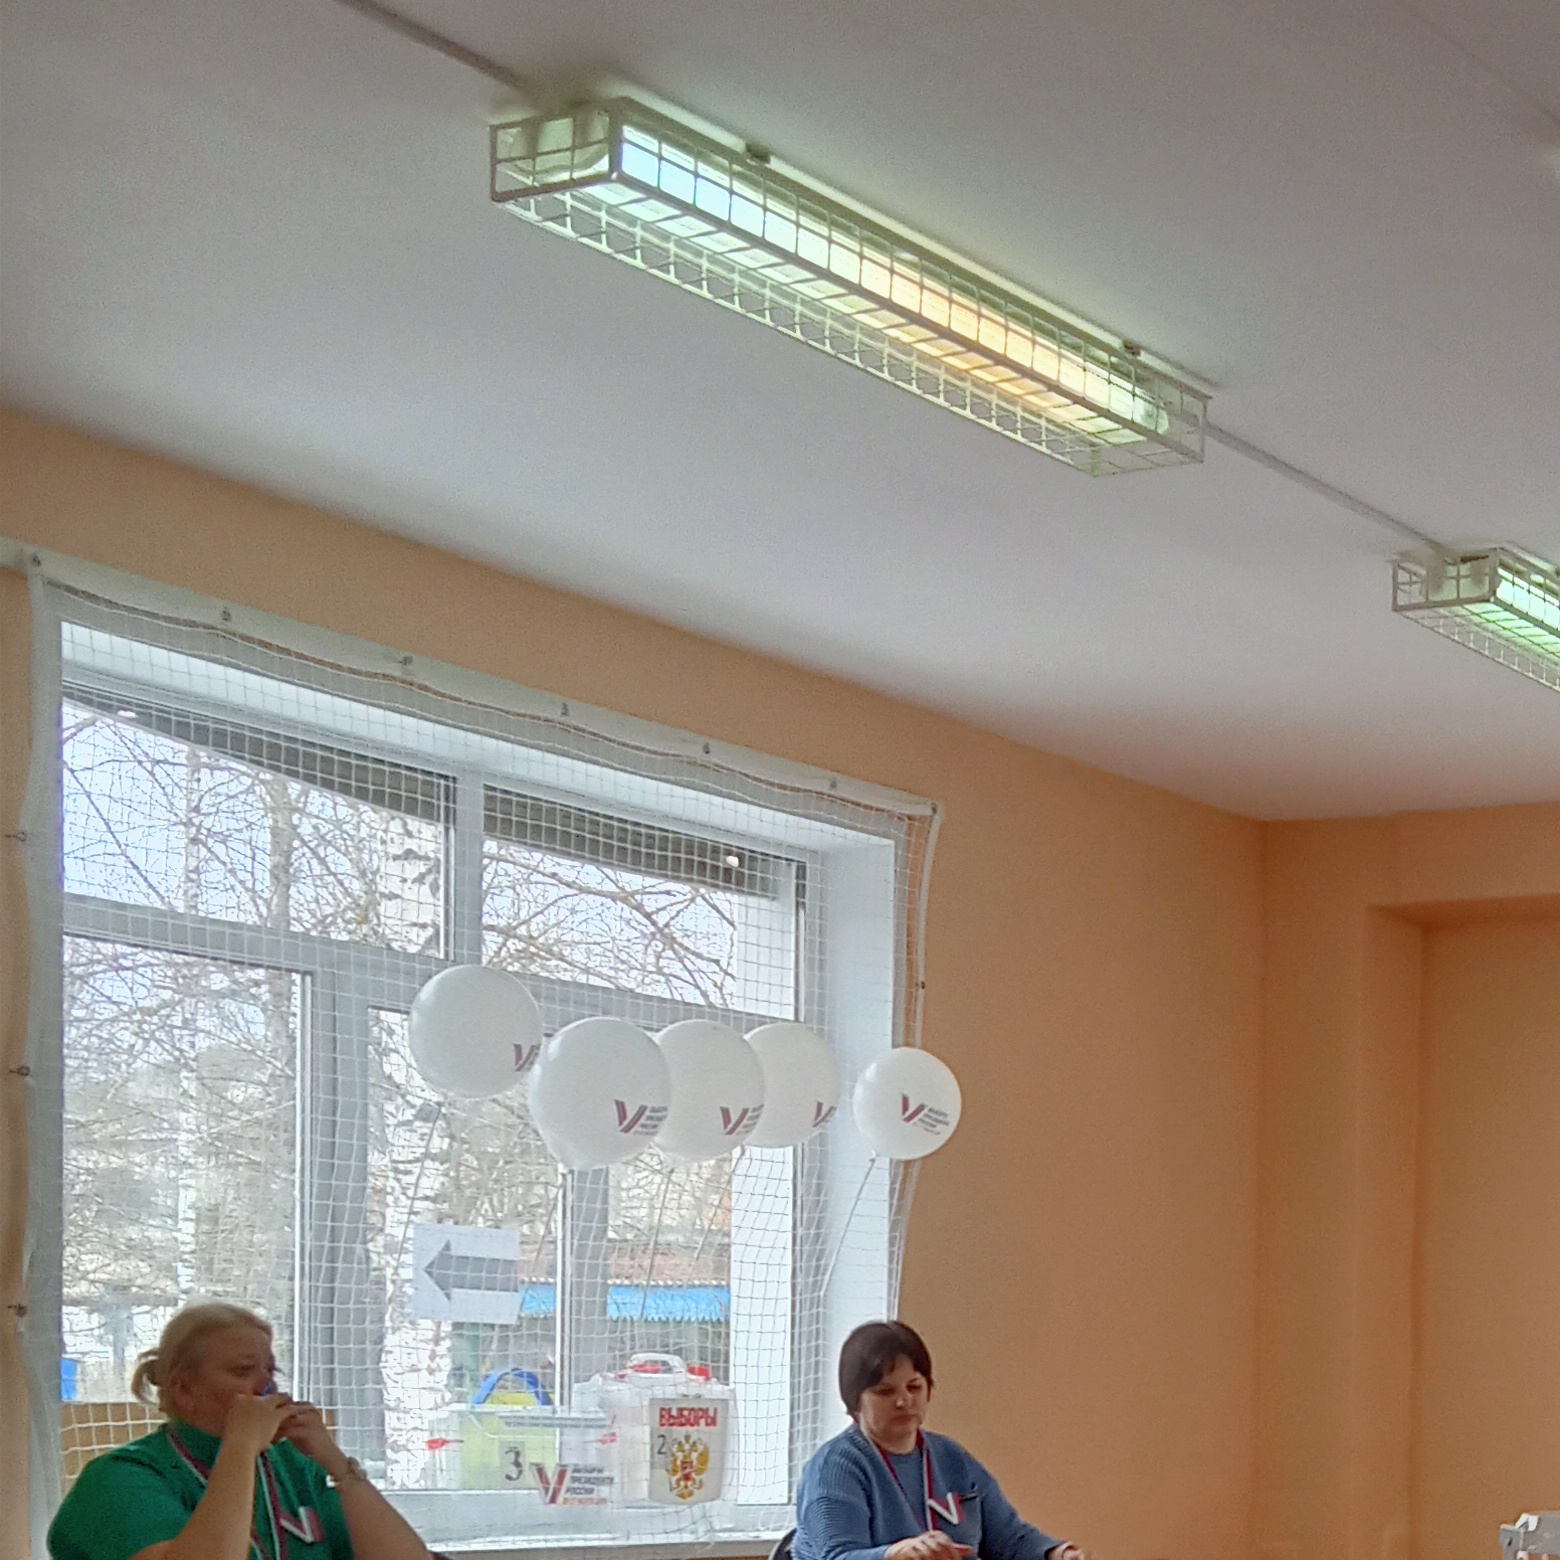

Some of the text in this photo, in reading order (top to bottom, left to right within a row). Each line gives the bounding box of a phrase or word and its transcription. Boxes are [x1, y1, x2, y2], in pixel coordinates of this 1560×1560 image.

[659, 1406, 718, 1428] ВЫБОРЫ
[657, 1434, 667, 1455] 2
[504, 1446, 523, 1481] 3
